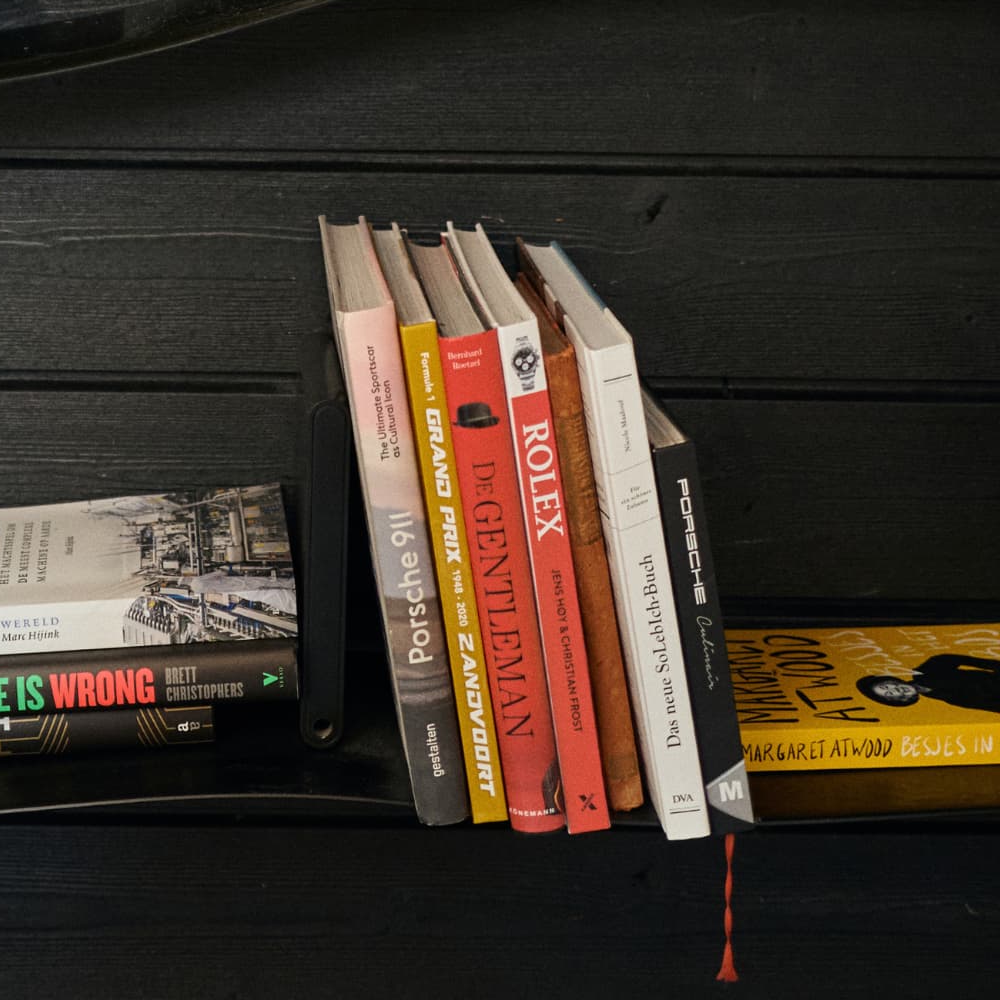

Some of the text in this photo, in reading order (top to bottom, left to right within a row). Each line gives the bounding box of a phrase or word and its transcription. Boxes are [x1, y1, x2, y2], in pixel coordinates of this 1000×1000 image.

[367, 345, 390, 462] The Ultimate Sportscar
[383, 379, 401, 459] as Cultural Icon
[522, 418, 564, 542] ROLEX
[420, 352, 496, 798] Formule GRAND PRIX 1948 2020 ZANDVOORT
[677, 478, 707, 606] PORSCHE
[388, 511, 433, 665] Porsche 911
[472, 461, 535, 739] DE GENTLEMAN
[0, 616, 60, 629] WERELD
[1, 632, 27, 643] Marc
[28, 629, 60, 642] Hijink
[551, 569, 583, 732] JENS HOY & CHRISTIAN FROST
[638, 554, 681, 750] Das neue SoLebIch-Buch
[16, 674, 45, 712] IS
[49, 667, 156, 709] WRONG
[164, 666, 197, 685] BRETT
[165, 682, 244, 702] CHRISTOPHERS
[426, 722, 445, 778] gestalten
[743, 735, 994, 762] MARGARET ATWOOD BESJES IN
[672, 794, 694, 804] DVA
[719, 780, 744, 802] M
